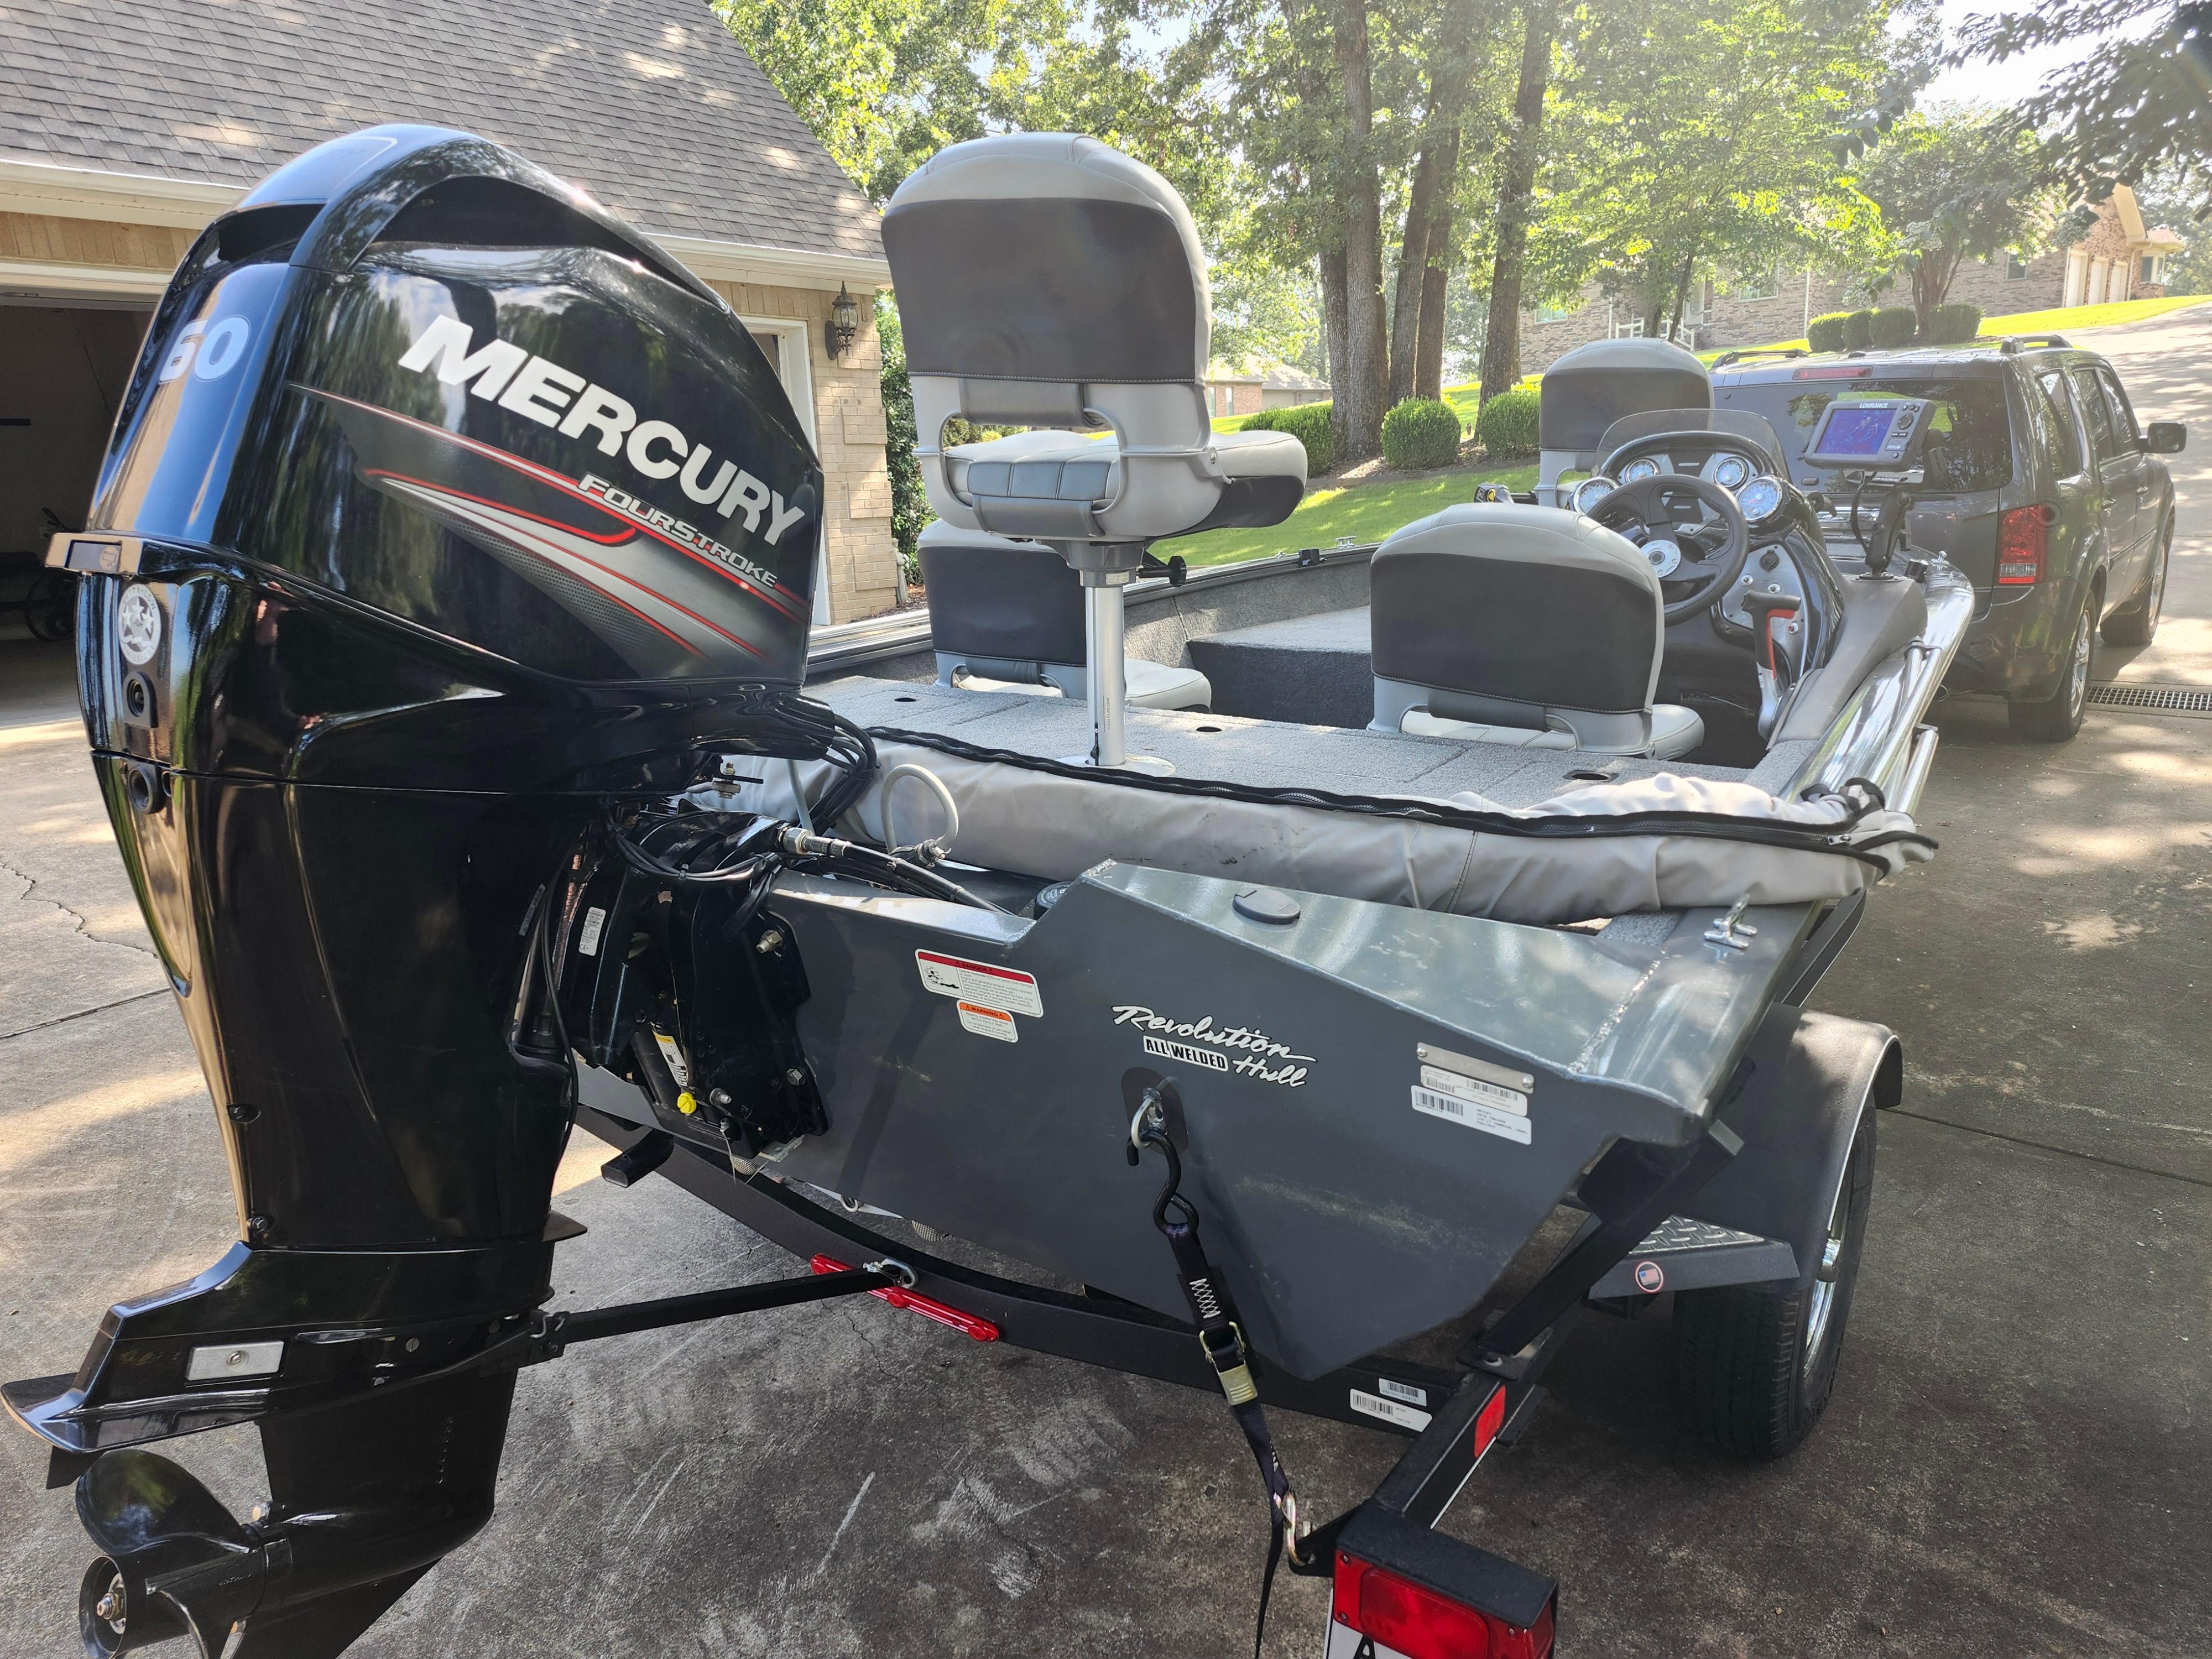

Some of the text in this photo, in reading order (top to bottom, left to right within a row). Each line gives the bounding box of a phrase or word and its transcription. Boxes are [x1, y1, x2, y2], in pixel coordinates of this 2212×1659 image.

[160, 315, 251, 384] 60
[398, 315, 805, 546] MERCURY
[578, 473, 778, 588] FOURSTROKE
[962, 962, 988, 972] DANGER
[971, 1006, 998, 1016] WARNING
[1111, 1004, 1318, 1063] Revolution
[1146, 1039, 1226, 1070] ALL WELDED
[1232, 1055, 1308, 1087] Hull
